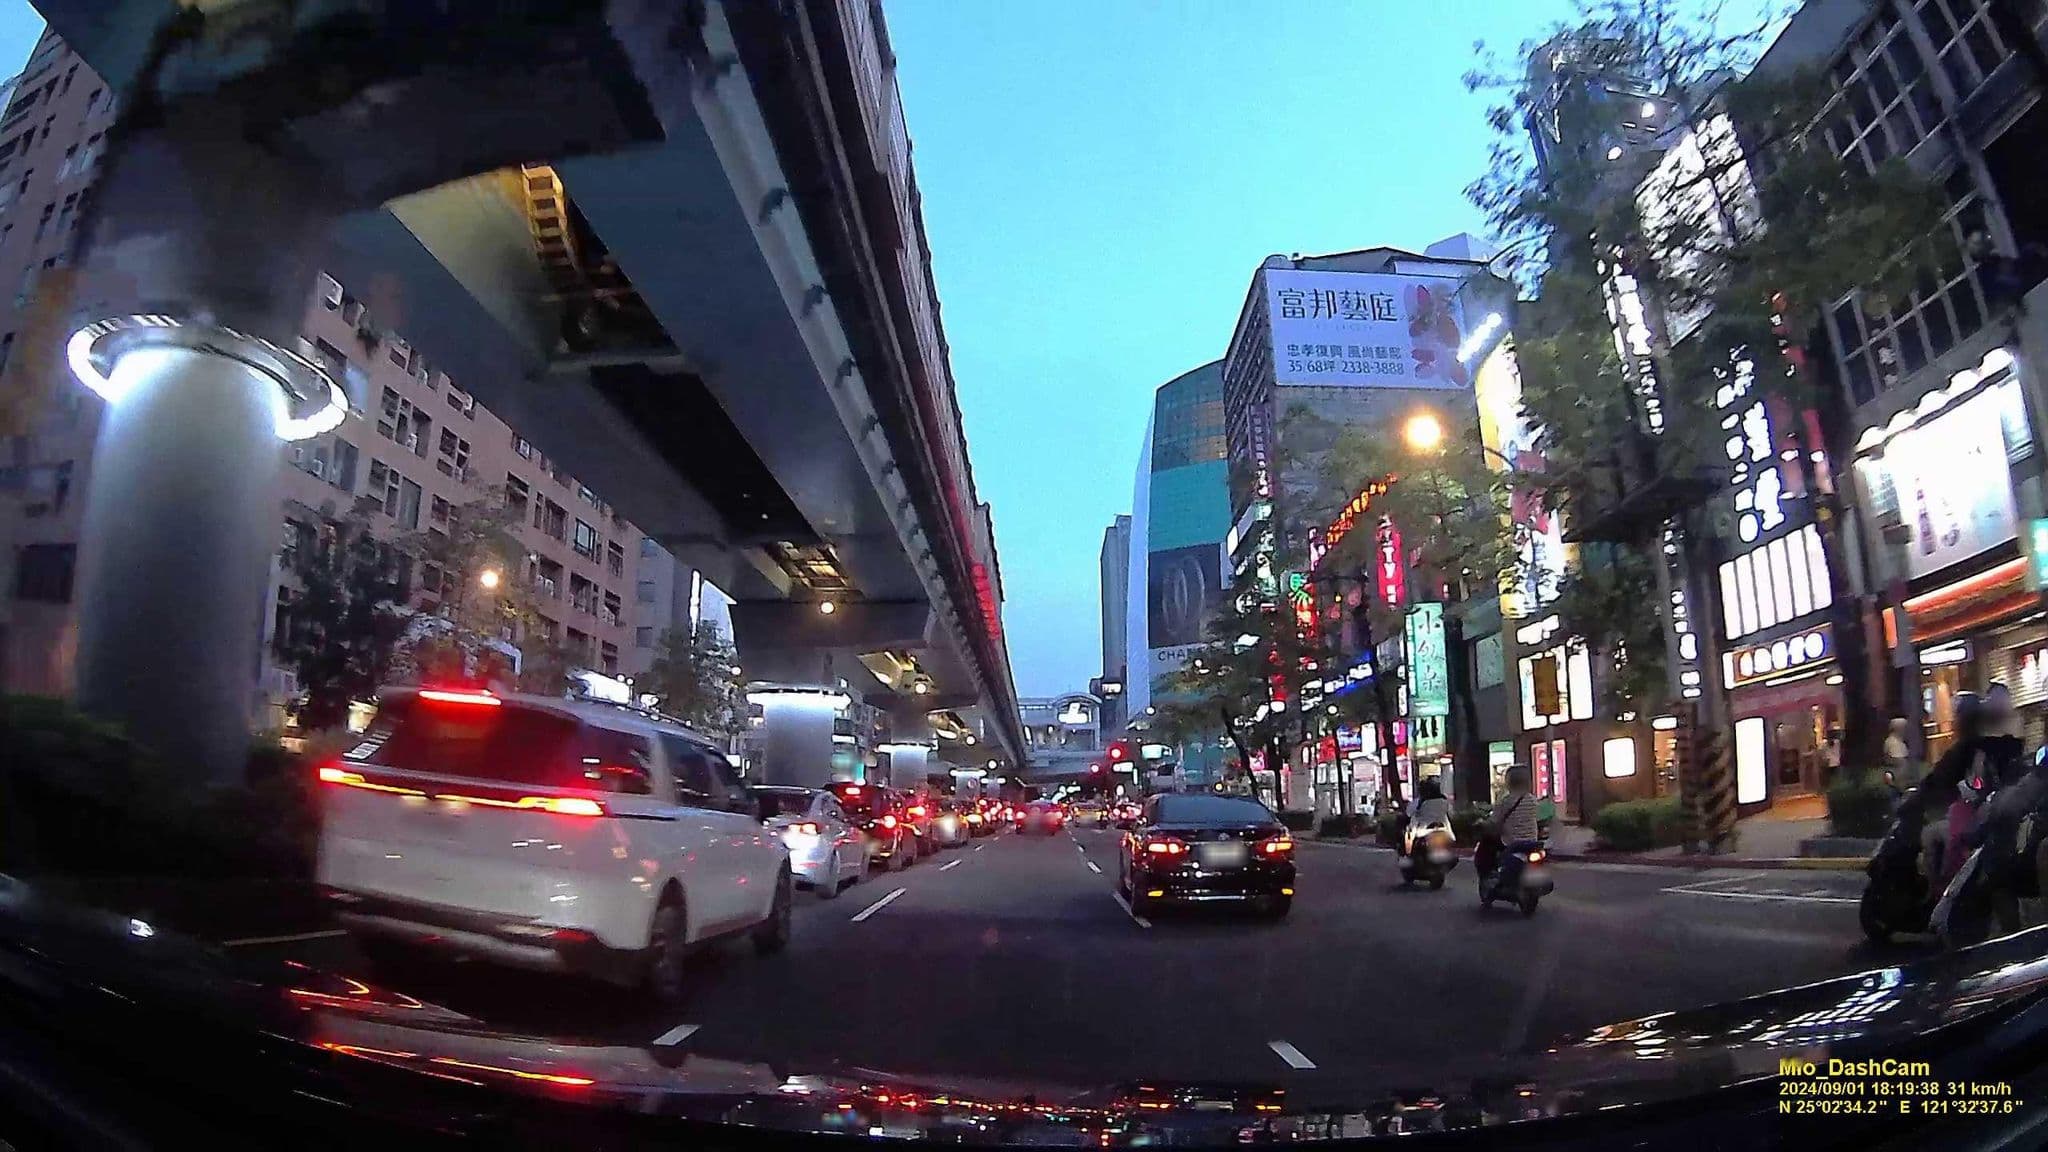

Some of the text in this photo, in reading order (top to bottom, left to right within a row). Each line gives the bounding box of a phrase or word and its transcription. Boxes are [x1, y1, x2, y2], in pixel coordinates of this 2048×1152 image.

[1278, 288, 1398, 321] 富邦藝庭
[1287, 344, 1343, 358] 忠孝復興
[1342, 361, 1405, 375] 2338-3888
